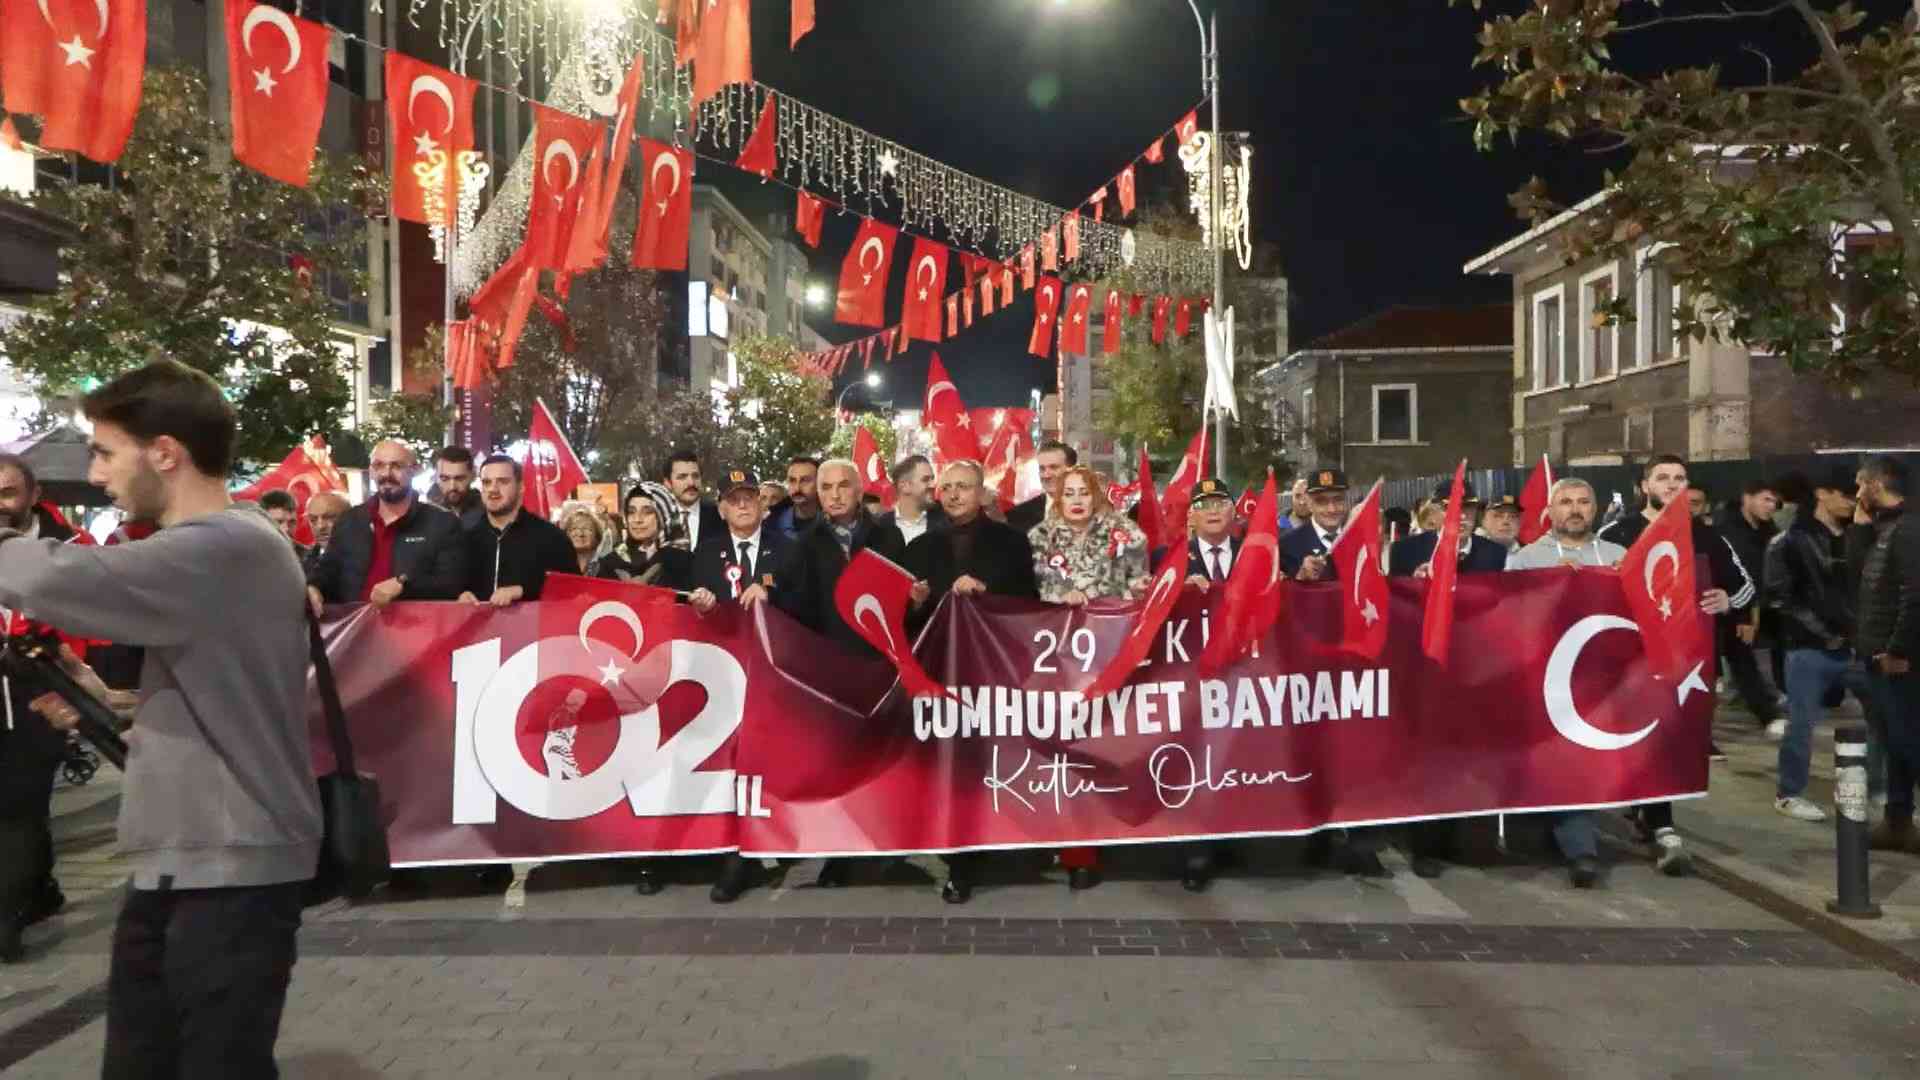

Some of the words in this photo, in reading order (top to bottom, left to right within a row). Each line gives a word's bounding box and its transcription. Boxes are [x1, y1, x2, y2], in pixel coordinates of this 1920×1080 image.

[1033, 628, 1097, 673] 29
[452, 634, 747, 824] 102
[1199, 669, 1389, 729] BAYRAMI
[1150, 743, 1312, 808] Olsun
